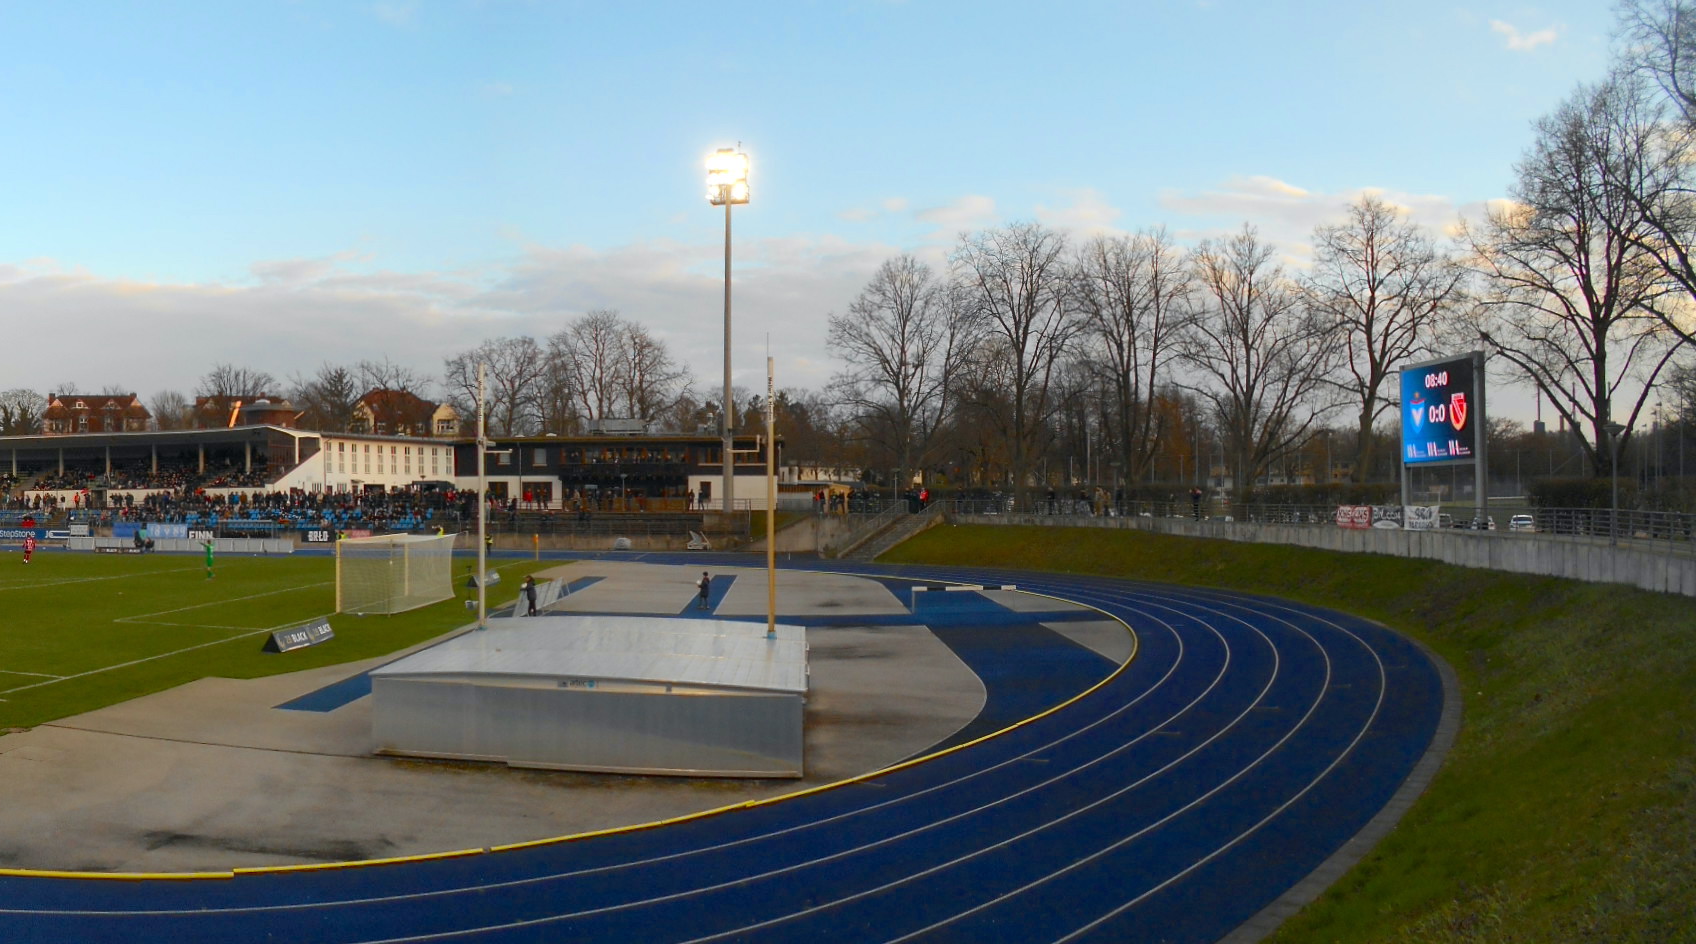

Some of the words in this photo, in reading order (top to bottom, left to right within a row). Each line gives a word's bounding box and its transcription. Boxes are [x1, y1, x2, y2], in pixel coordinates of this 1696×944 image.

[1425, 371, 1448, 389] 08:40
[1429, 403, 1445, 423] 0:0
[0, 529, 35, 539] StepStone
[189, 531, 213, 539] FINN
[291, 631, 308, 643] BLACK
[317, 623, 331, 635] BLACK
